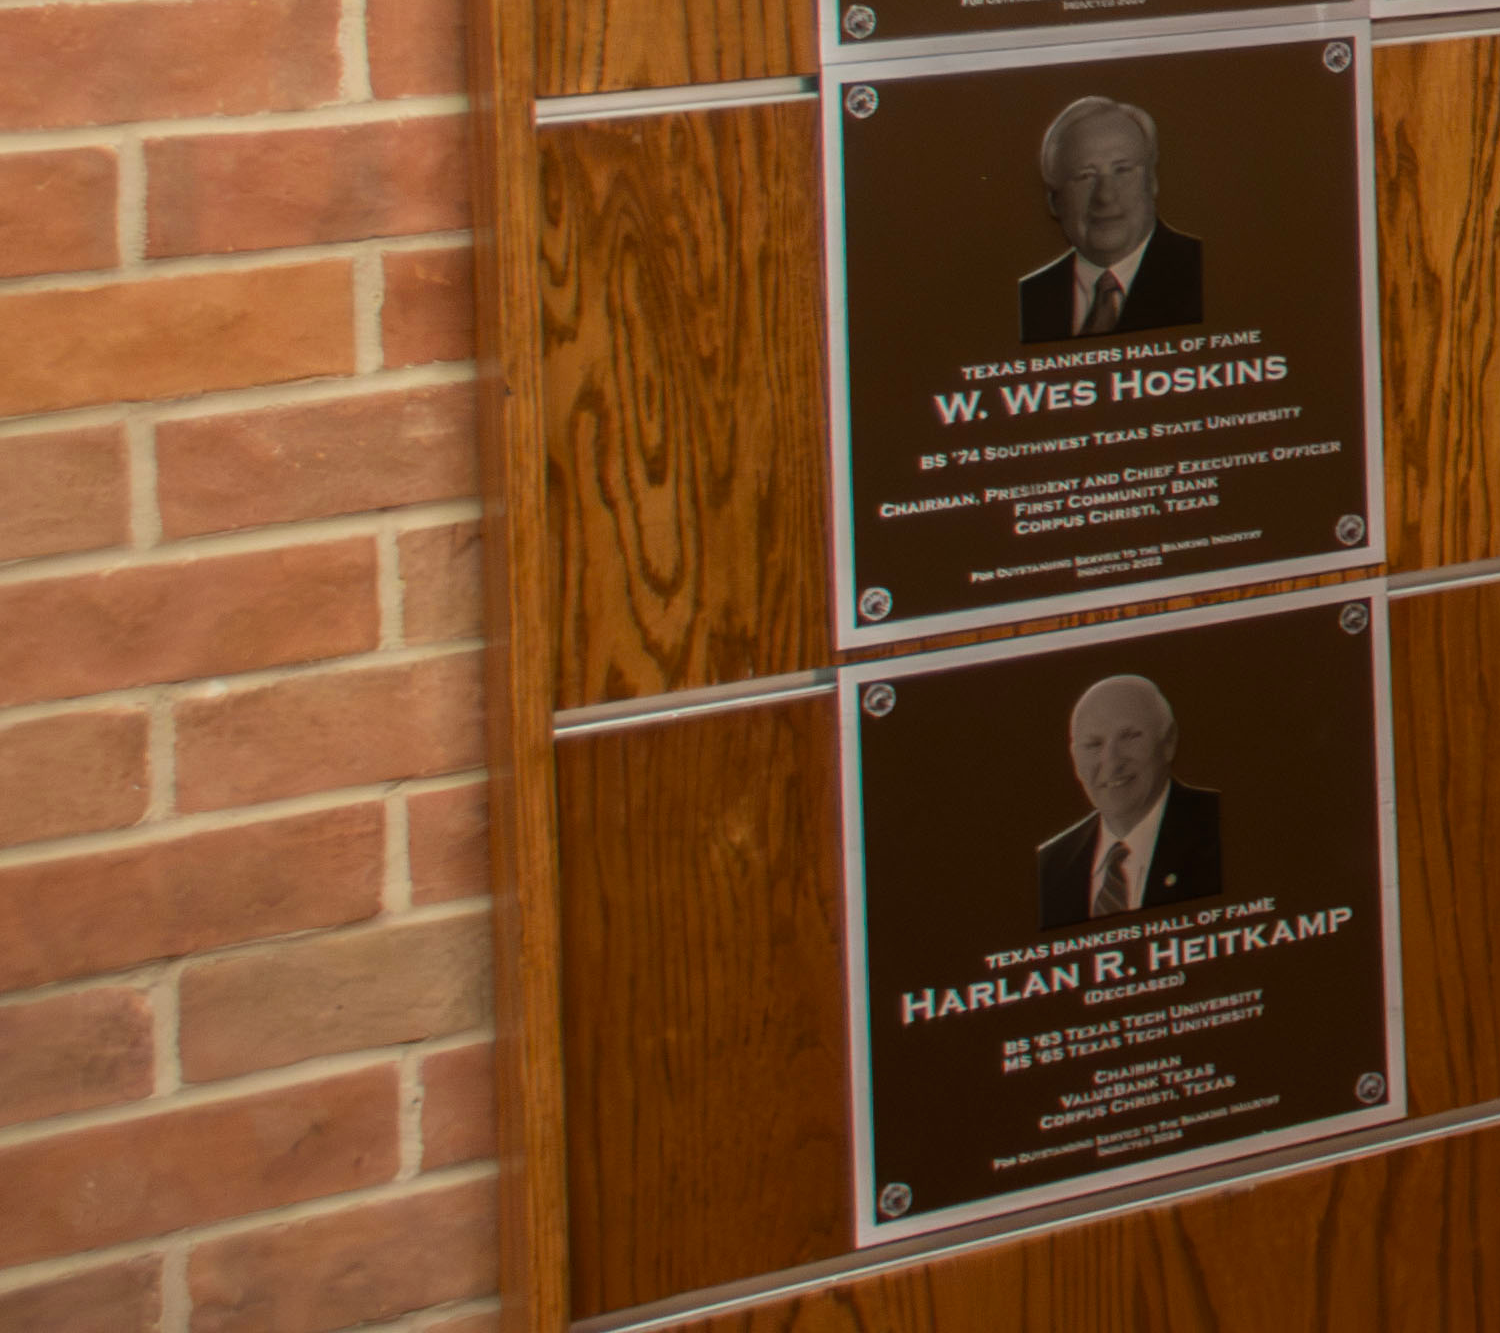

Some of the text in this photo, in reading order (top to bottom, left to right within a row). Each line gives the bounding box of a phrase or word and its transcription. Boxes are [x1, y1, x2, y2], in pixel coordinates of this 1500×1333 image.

[934, 356, 1287, 424] W. WES HOSKINS
[962, 331, 1260, 380] TEXAS BANKERS HALL OF FAME
[902, 907, 1352, 1024] HARLAN R. HEITKAMP
[985, 898, 1274, 969] TEXAS BANKERS HALL OF FAME
